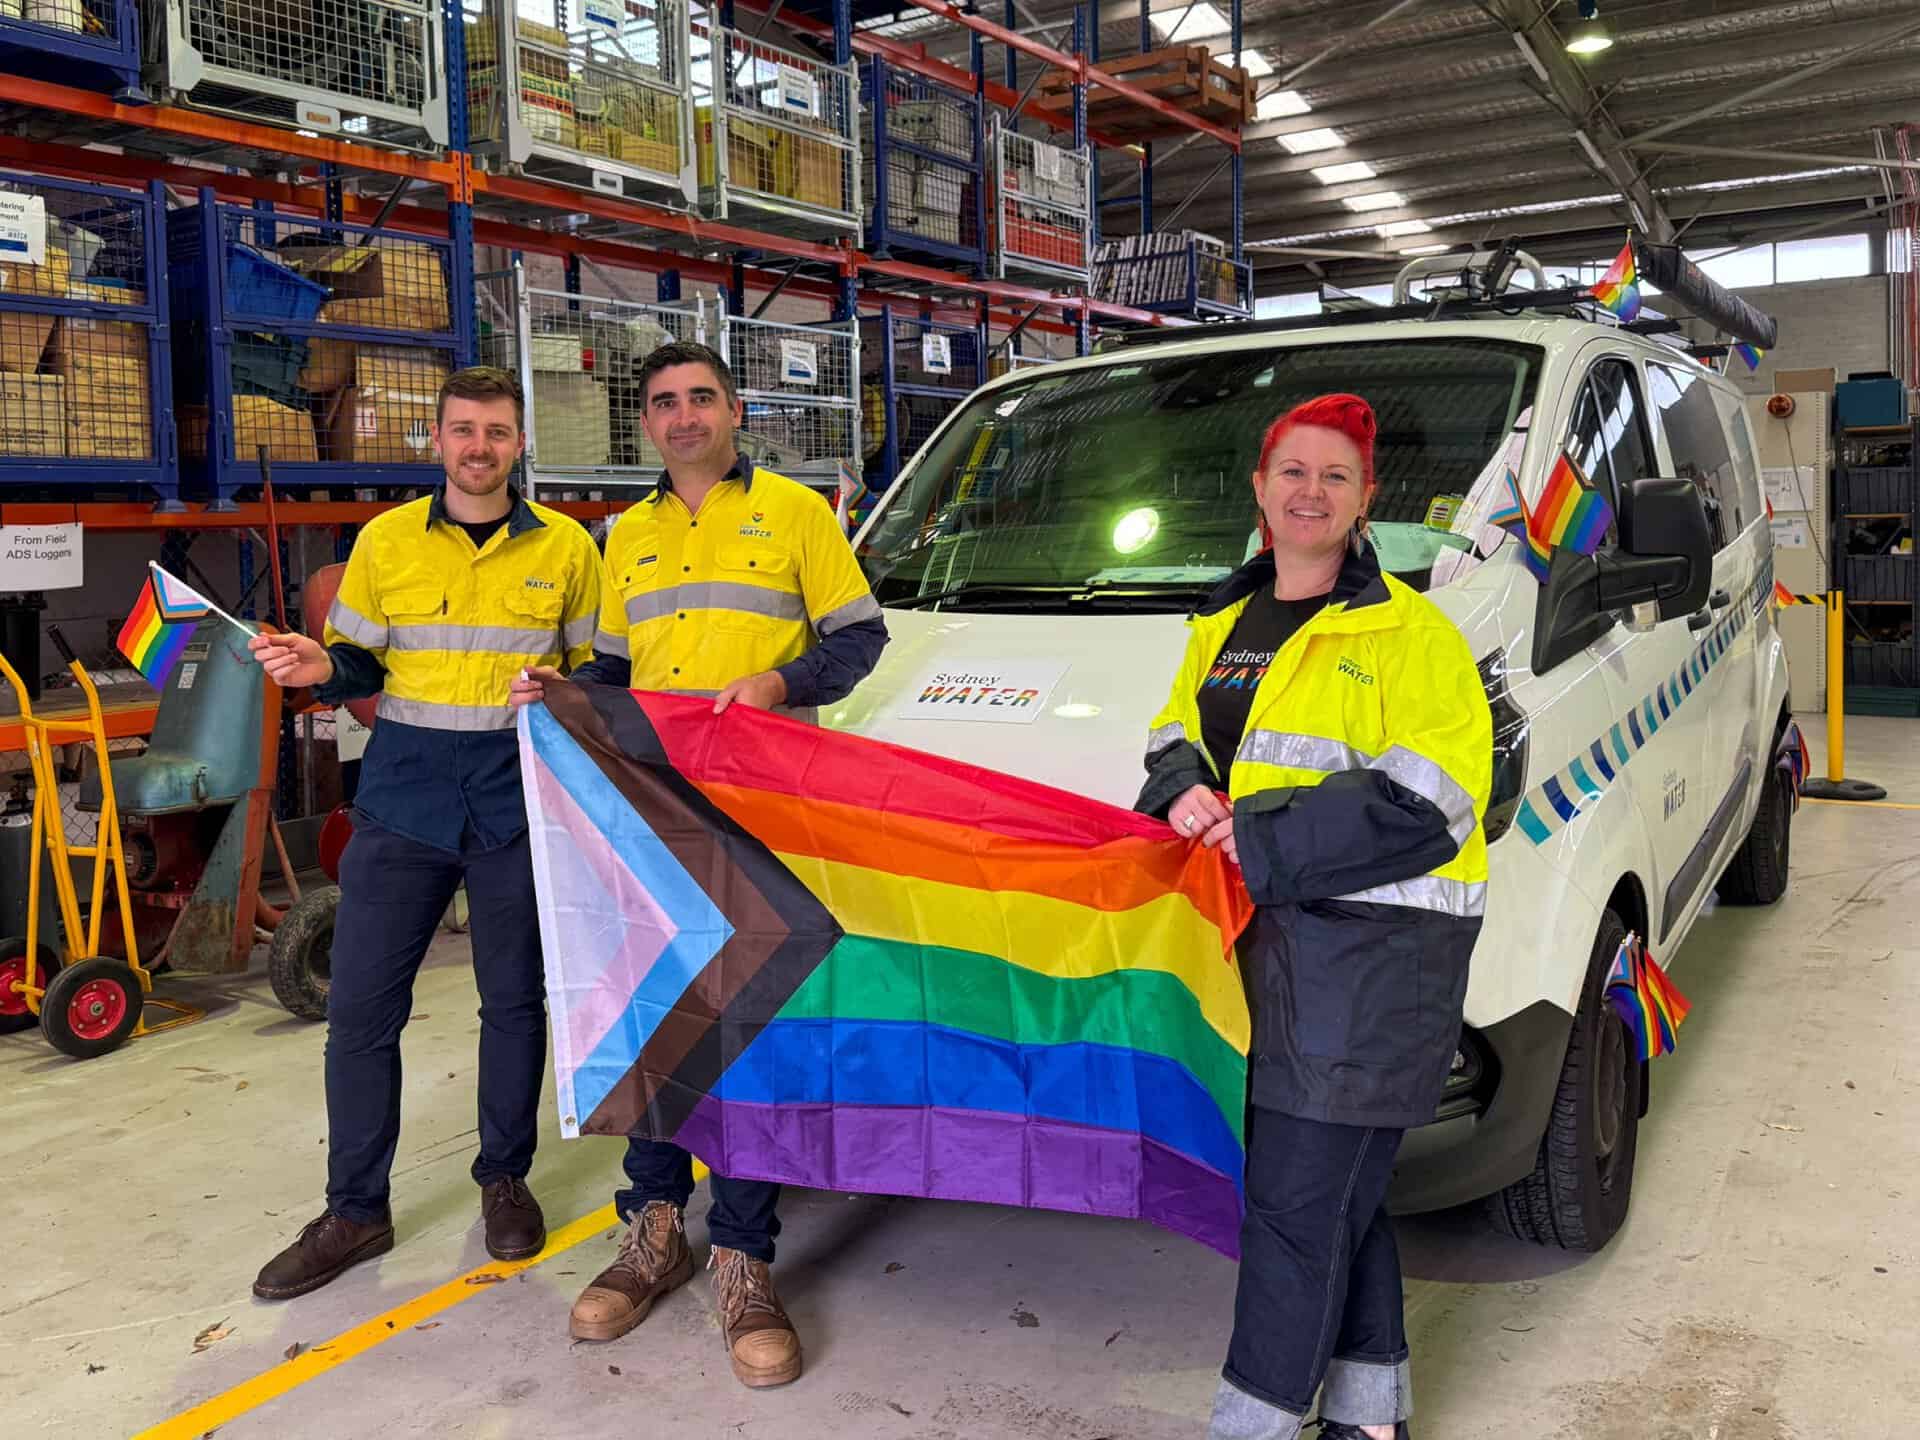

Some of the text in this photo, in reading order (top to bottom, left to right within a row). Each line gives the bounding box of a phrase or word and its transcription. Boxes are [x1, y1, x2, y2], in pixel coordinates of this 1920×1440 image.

[14, 533, 67, 545] From Field
[6, 549, 72, 561] ADS Loggers
[932, 673, 1001, 687] Sydney
[1206, 666, 1270, 689] WAT
[917, 686, 1040, 707] WATER
